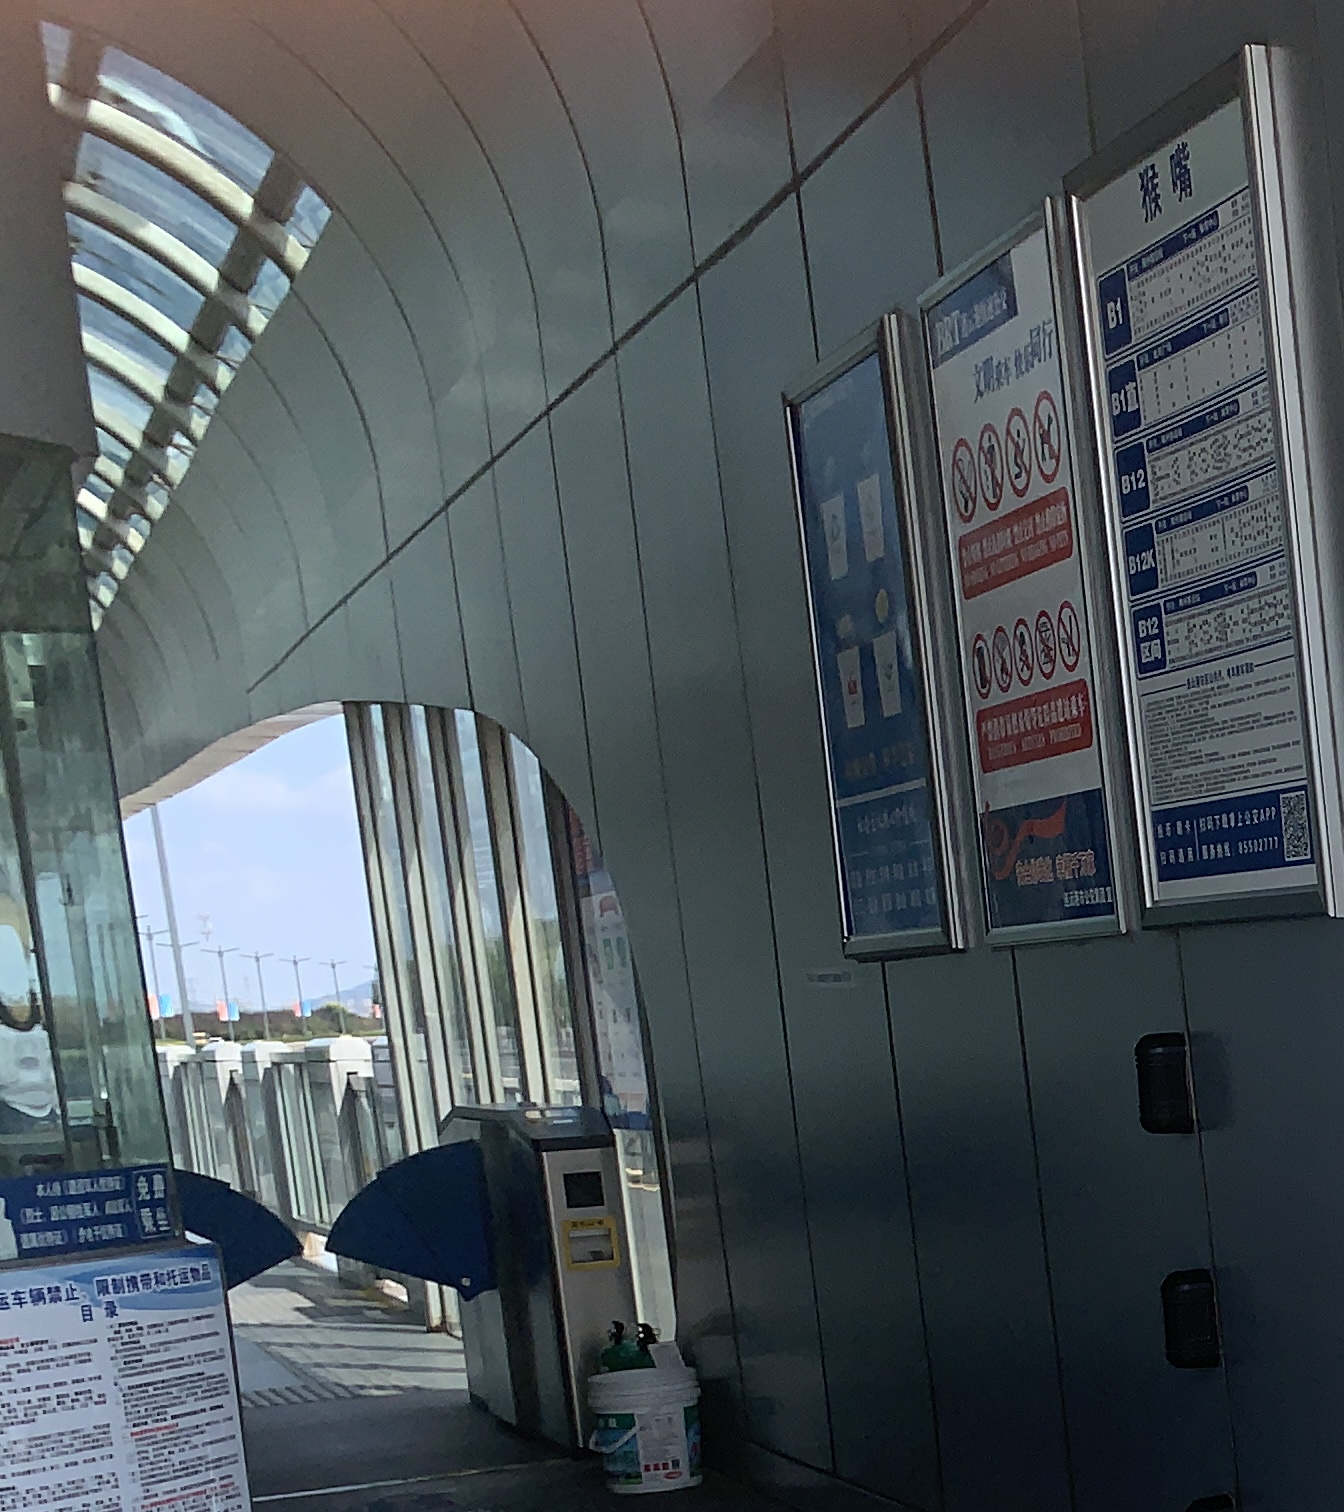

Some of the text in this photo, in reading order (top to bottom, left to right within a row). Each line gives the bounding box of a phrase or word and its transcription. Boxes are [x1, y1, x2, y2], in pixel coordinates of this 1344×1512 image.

[1138, 141, 1193, 223] 猴嘴
[1106, 295, 1125, 329] B1
[1121, 467, 1146, 497] B12
[1128, 547, 1156, 575] B12K
[1138, 615, 1160, 639] B12
[81, 1300, 119, 1323] 目录
